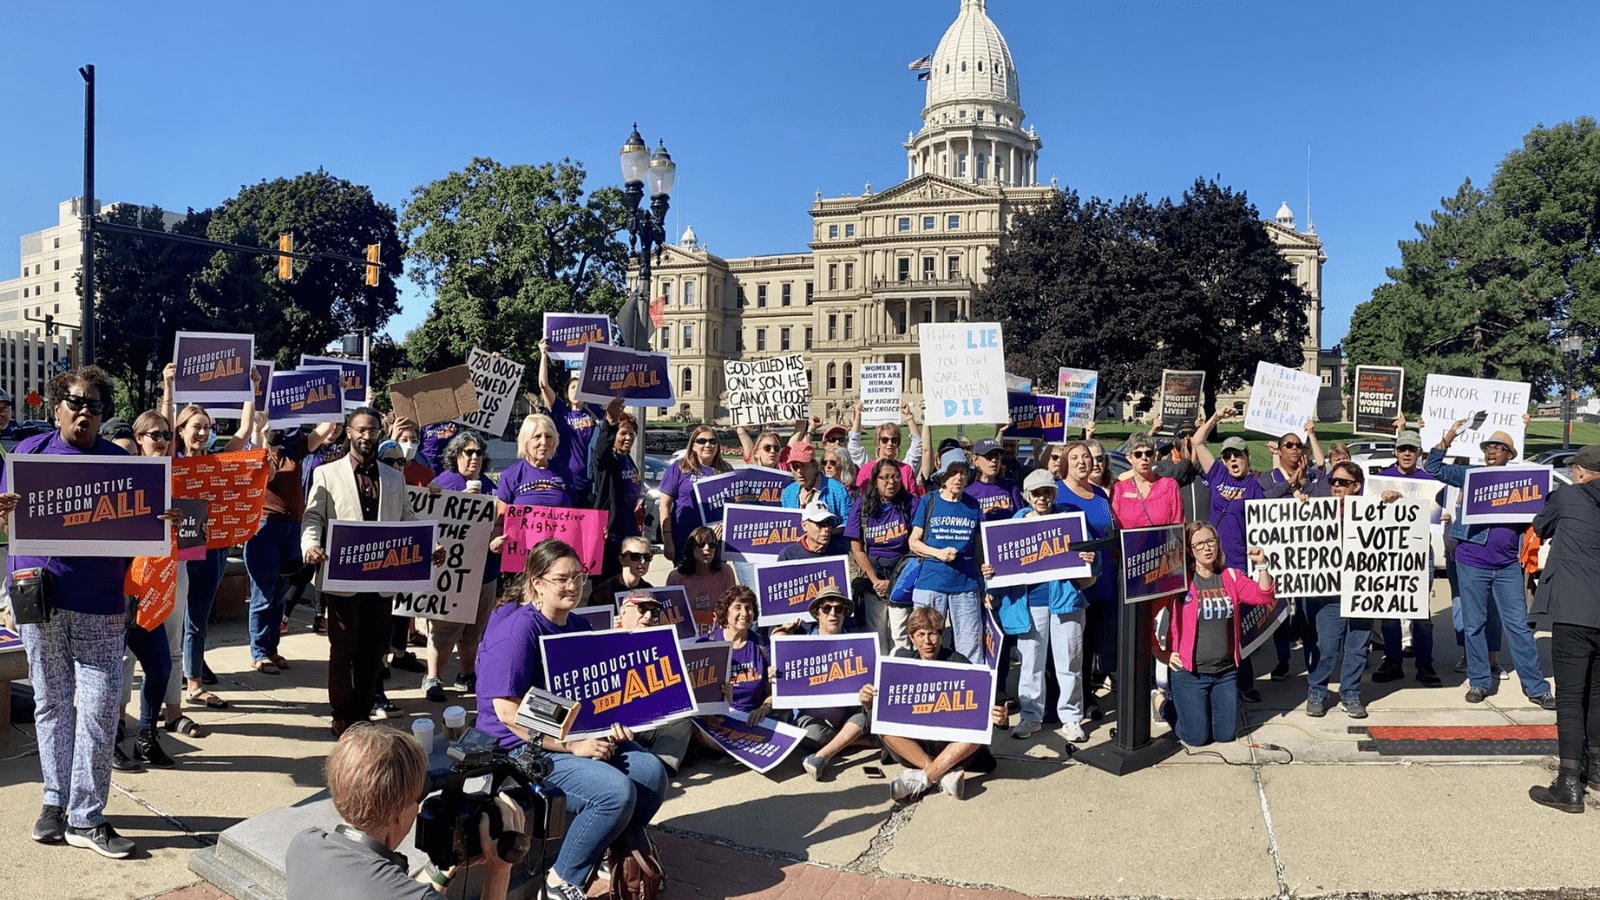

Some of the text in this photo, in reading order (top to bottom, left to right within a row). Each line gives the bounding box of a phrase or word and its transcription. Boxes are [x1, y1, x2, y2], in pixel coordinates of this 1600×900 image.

[552, 324, 598, 336] REPRODUCTIVE
[552, 332, 580, 342] FREEDOM
[579, 328, 605, 345] ALL
[967, 329, 998, 349] LIE
[183, 348, 236, 367] REPRODUCTIVE
[471, 351, 522, 379] 750,000+
[726, 354, 804, 376] GOD KILLED HIS
[937, 356, 957, 367] YOU
[182, 363, 216, 377] FREEDOM
[214, 355, 244, 379] ALL
[594, 364, 648, 374] REPRODUCTIVE
[934, 369, 981, 382] CARE IF
[592, 372, 625, 381] FREEDOM
[623, 370, 660, 388] ALL
[788, 372, 806, 388] HE
[272, 393, 306, 406] FREEDOM
[307, 384, 336, 404] ALL
[730, 389, 810, 406] CANNOT CHOOSE
[931, 382, 989, 399] WOMEN
[1360, 392, 1394, 400] PROTECT
[1431, 385, 1522, 405] HONOR THE
[482, 394, 502, 412] US
[944, 398, 984, 418] DIE
[1010, 404, 1055, 414] PRODUCTIVE
[1359, 406, 1382, 414] LIVES!
[1360, 400, 1396, 408] WOMEN'S
[462, 410, 495, 429] VOTE
[730, 407, 744, 426] IF
[758, 404, 782, 422] HAVE
[784, 404, 809, 420] ONE
[1032, 412, 1063, 429] ALL
[1428, 406, 1457, 420] WILL
[1492, 412, 1518, 426] THE
[1442, 429, 1486, 444] POPL
[29, 478, 133, 504] REPRODUCTIVE
[759, 488, 783, 502] AL
[1474, 478, 1532, 496] REPRODUCTIVE
[1508, 484, 1542, 504] ALL
[1474, 490, 1510, 504] FREEDOM
[29, 498, 93, 518] FREEDOM
[70, 490, 151, 523] FOR ALL
[444, 496, 494, 523] RFFA
[1248, 499, 1338, 526] MICHIGAN
[1352, 500, 1386, 522] Let
[189, 516, 196, 525] is
[520, 518, 567, 533] Rights
[734, 520, 792, 532] REPRODUCTIVE
[179, 528, 198, 538] Care.
[438, 523, 470, 540] THE
[733, 530, 769, 540] FREEDOM
[768, 527, 799, 544] ALL
[886, 524, 908, 540] ALL
[997, 528, 1062, 553] REPRODUCTIVE
[1248, 522, 1338, 546] COALITION
[340, 536, 413, 555] REPRODUCTIVE
[998, 545, 1038, 562] FREEDOM
[1127, 539, 1176, 568] REPRODUCTIVE
[340, 550, 384, 564] FREEDOM
[382, 544, 422, 568] ALL
[1284, 546, 1342, 570] REPRO
[1344, 552, 1426, 572] ABORTION
[1128, 558, 1160, 580] FREEDOM
[768, 570, 828, 594] REPRODUCTIVE
[1270, 571, 1341, 594] ERATION
[1354, 575, 1420, 593] RIGHTS
[768, 585, 805, 602] FREEDOM
[1198, 588, 1226, 598] OTE
[1199, 597, 1232, 608] OTE
[1350, 594, 1418, 613] FOR ALL
[1198, 607, 1234, 620] OTE
[554, 646, 659, 690] REPRODUCTIVE
[785, 648, 854, 670] REPRODUCTIVE
[736, 668, 762, 683] ALL
[786, 664, 828, 681] FREEDOM
[828, 656, 868, 682] ALL
[556, 674, 621, 700] REEDOM
[623, 656, 682, 704] ALL
[889, 680, 966, 694] REPRODUCTIVE
[888, 692, 936, 706] FREEDOM
[933, 690, 978, 712] ALL
